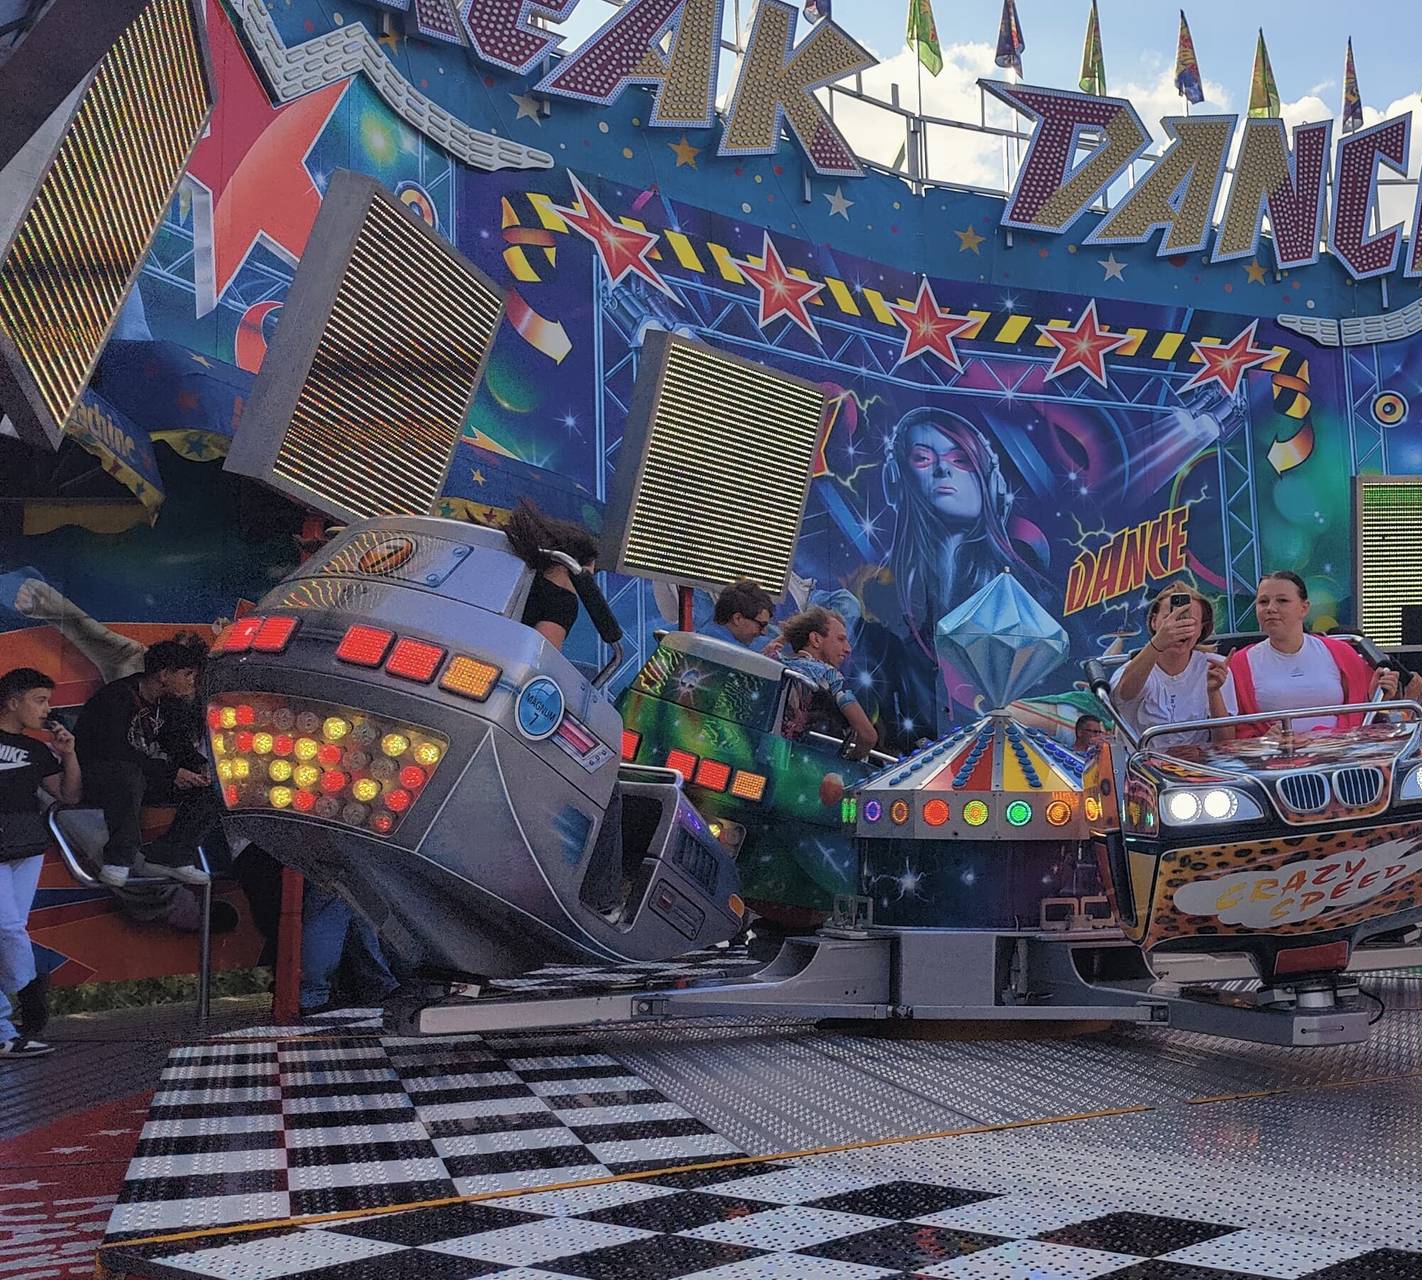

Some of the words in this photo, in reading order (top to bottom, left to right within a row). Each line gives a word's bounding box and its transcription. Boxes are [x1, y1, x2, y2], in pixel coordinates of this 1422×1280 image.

[377, 0, 879, 177] EAK
[1063, 505, 1189, 617] DANCE
[526, 693, 557, 721] MAGNUM
[528, 712, 539, 726] 7
[1215, 856, 1367, 911] CRAZY
[1269, 863, 1407, 921] SPEED
